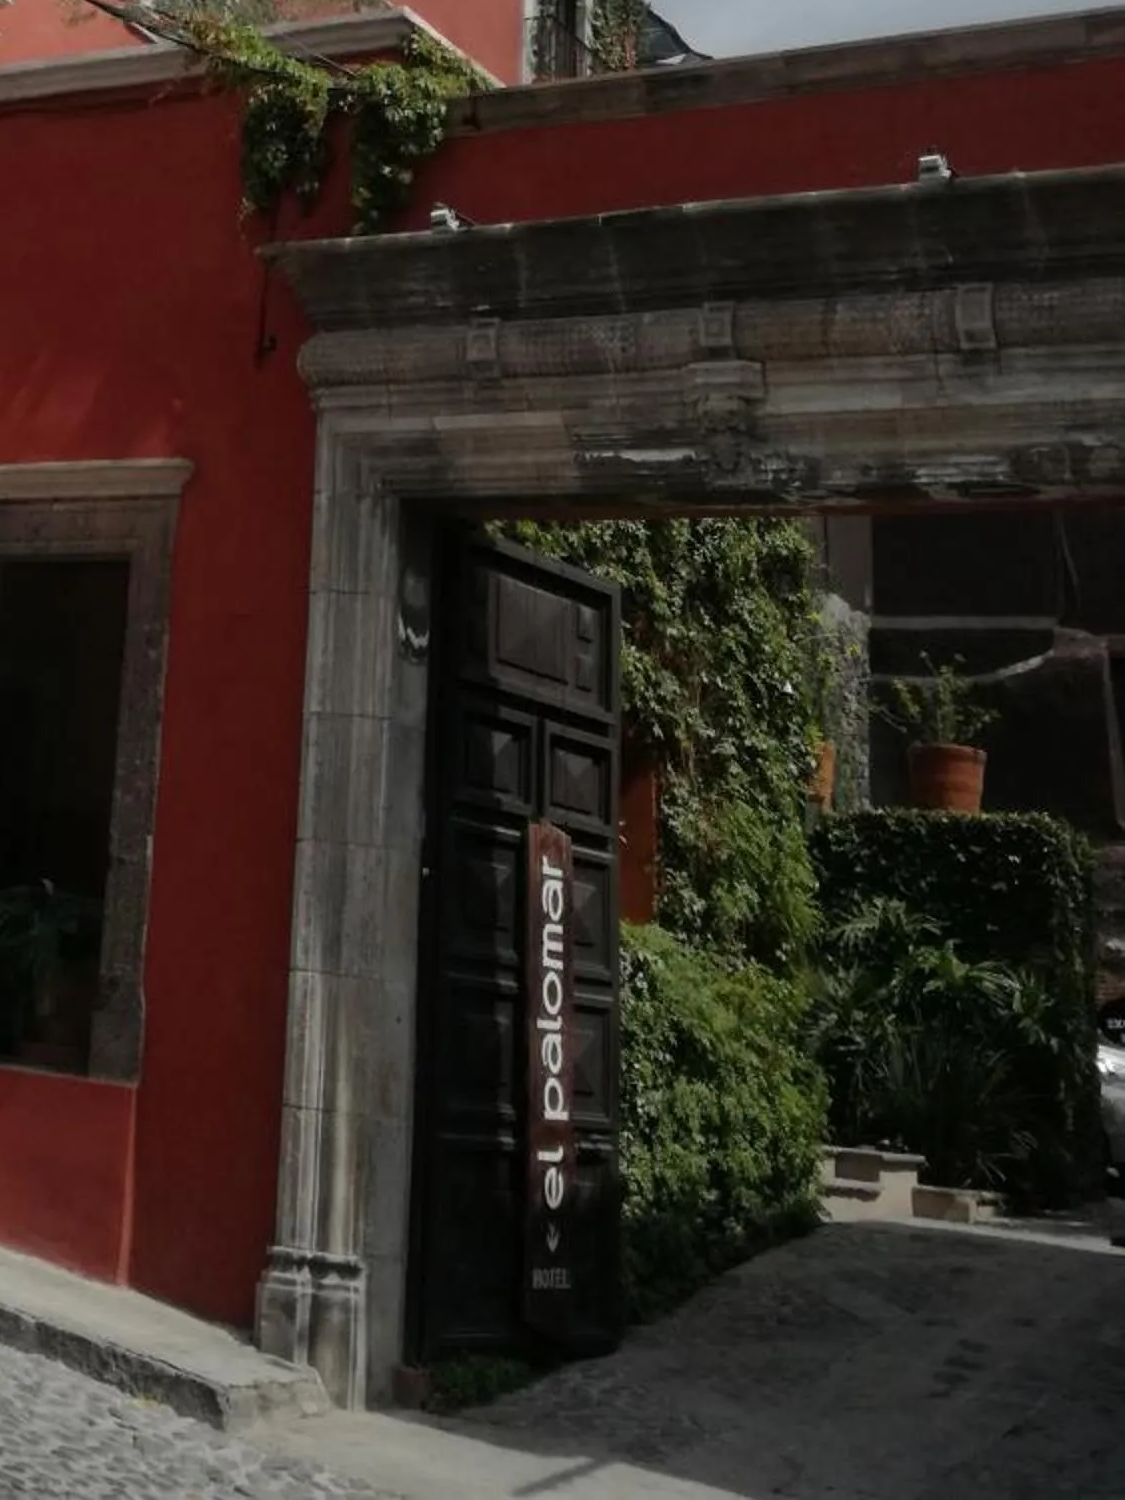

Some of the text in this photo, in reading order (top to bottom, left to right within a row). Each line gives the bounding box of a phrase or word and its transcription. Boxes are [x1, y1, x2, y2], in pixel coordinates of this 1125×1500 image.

[538, 855, 569, 1210] el palomar
[531, 1267, 572, 1290] HOTEL
